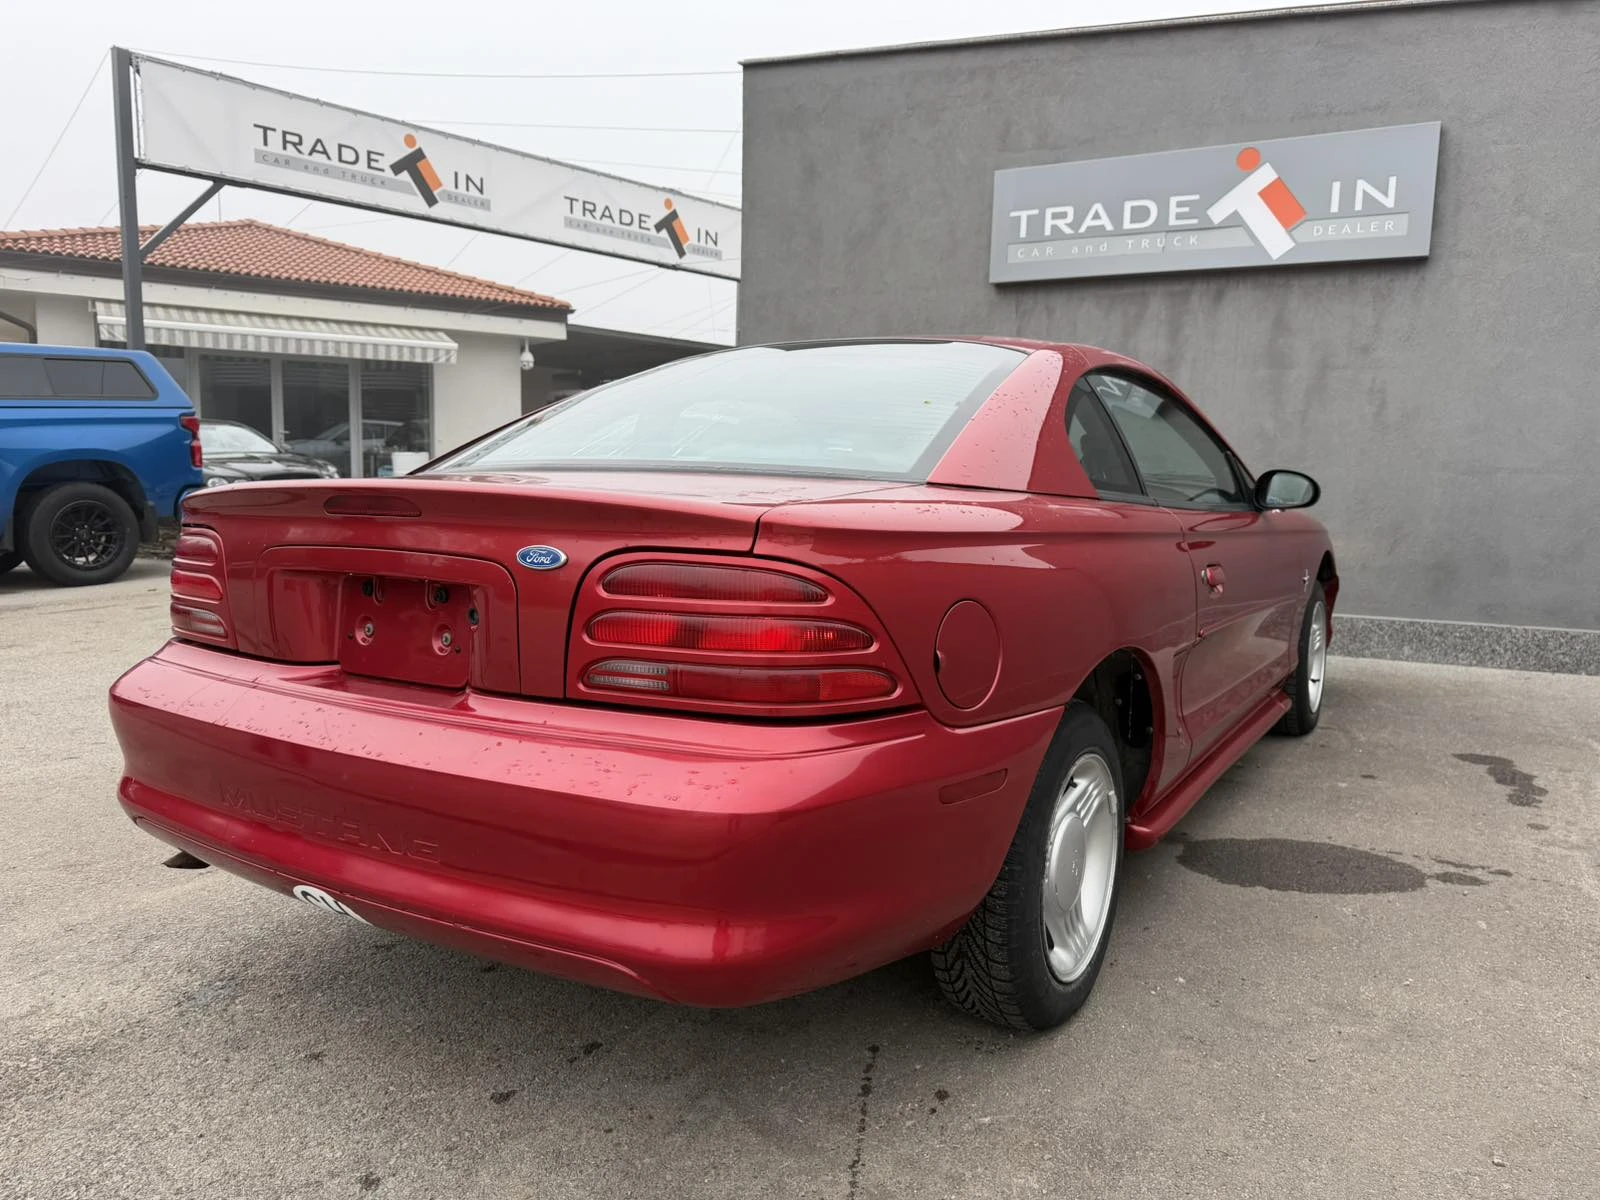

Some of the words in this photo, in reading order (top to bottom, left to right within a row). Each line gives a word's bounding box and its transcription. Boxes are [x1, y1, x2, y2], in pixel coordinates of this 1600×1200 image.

[253, 123, 385, 172] TRADE
[454, 171, 484, 195] IN
[261, 153, 291, 167] CAR
[563, 195, 652, 231] TRADE
[697, 226, 719, 247] IN
[1009, 193, 1201, 239] TRADE
[1329, 175, 1398, 214] IN
[1017, 245, 1056, 259] CAR
[1070, 240, 1109, 255] and
[1126, 234, 1200, 251] TRUCK
[1313, 220, 1396, 238] DEALER
[526, 549, 554, 564] Ford
